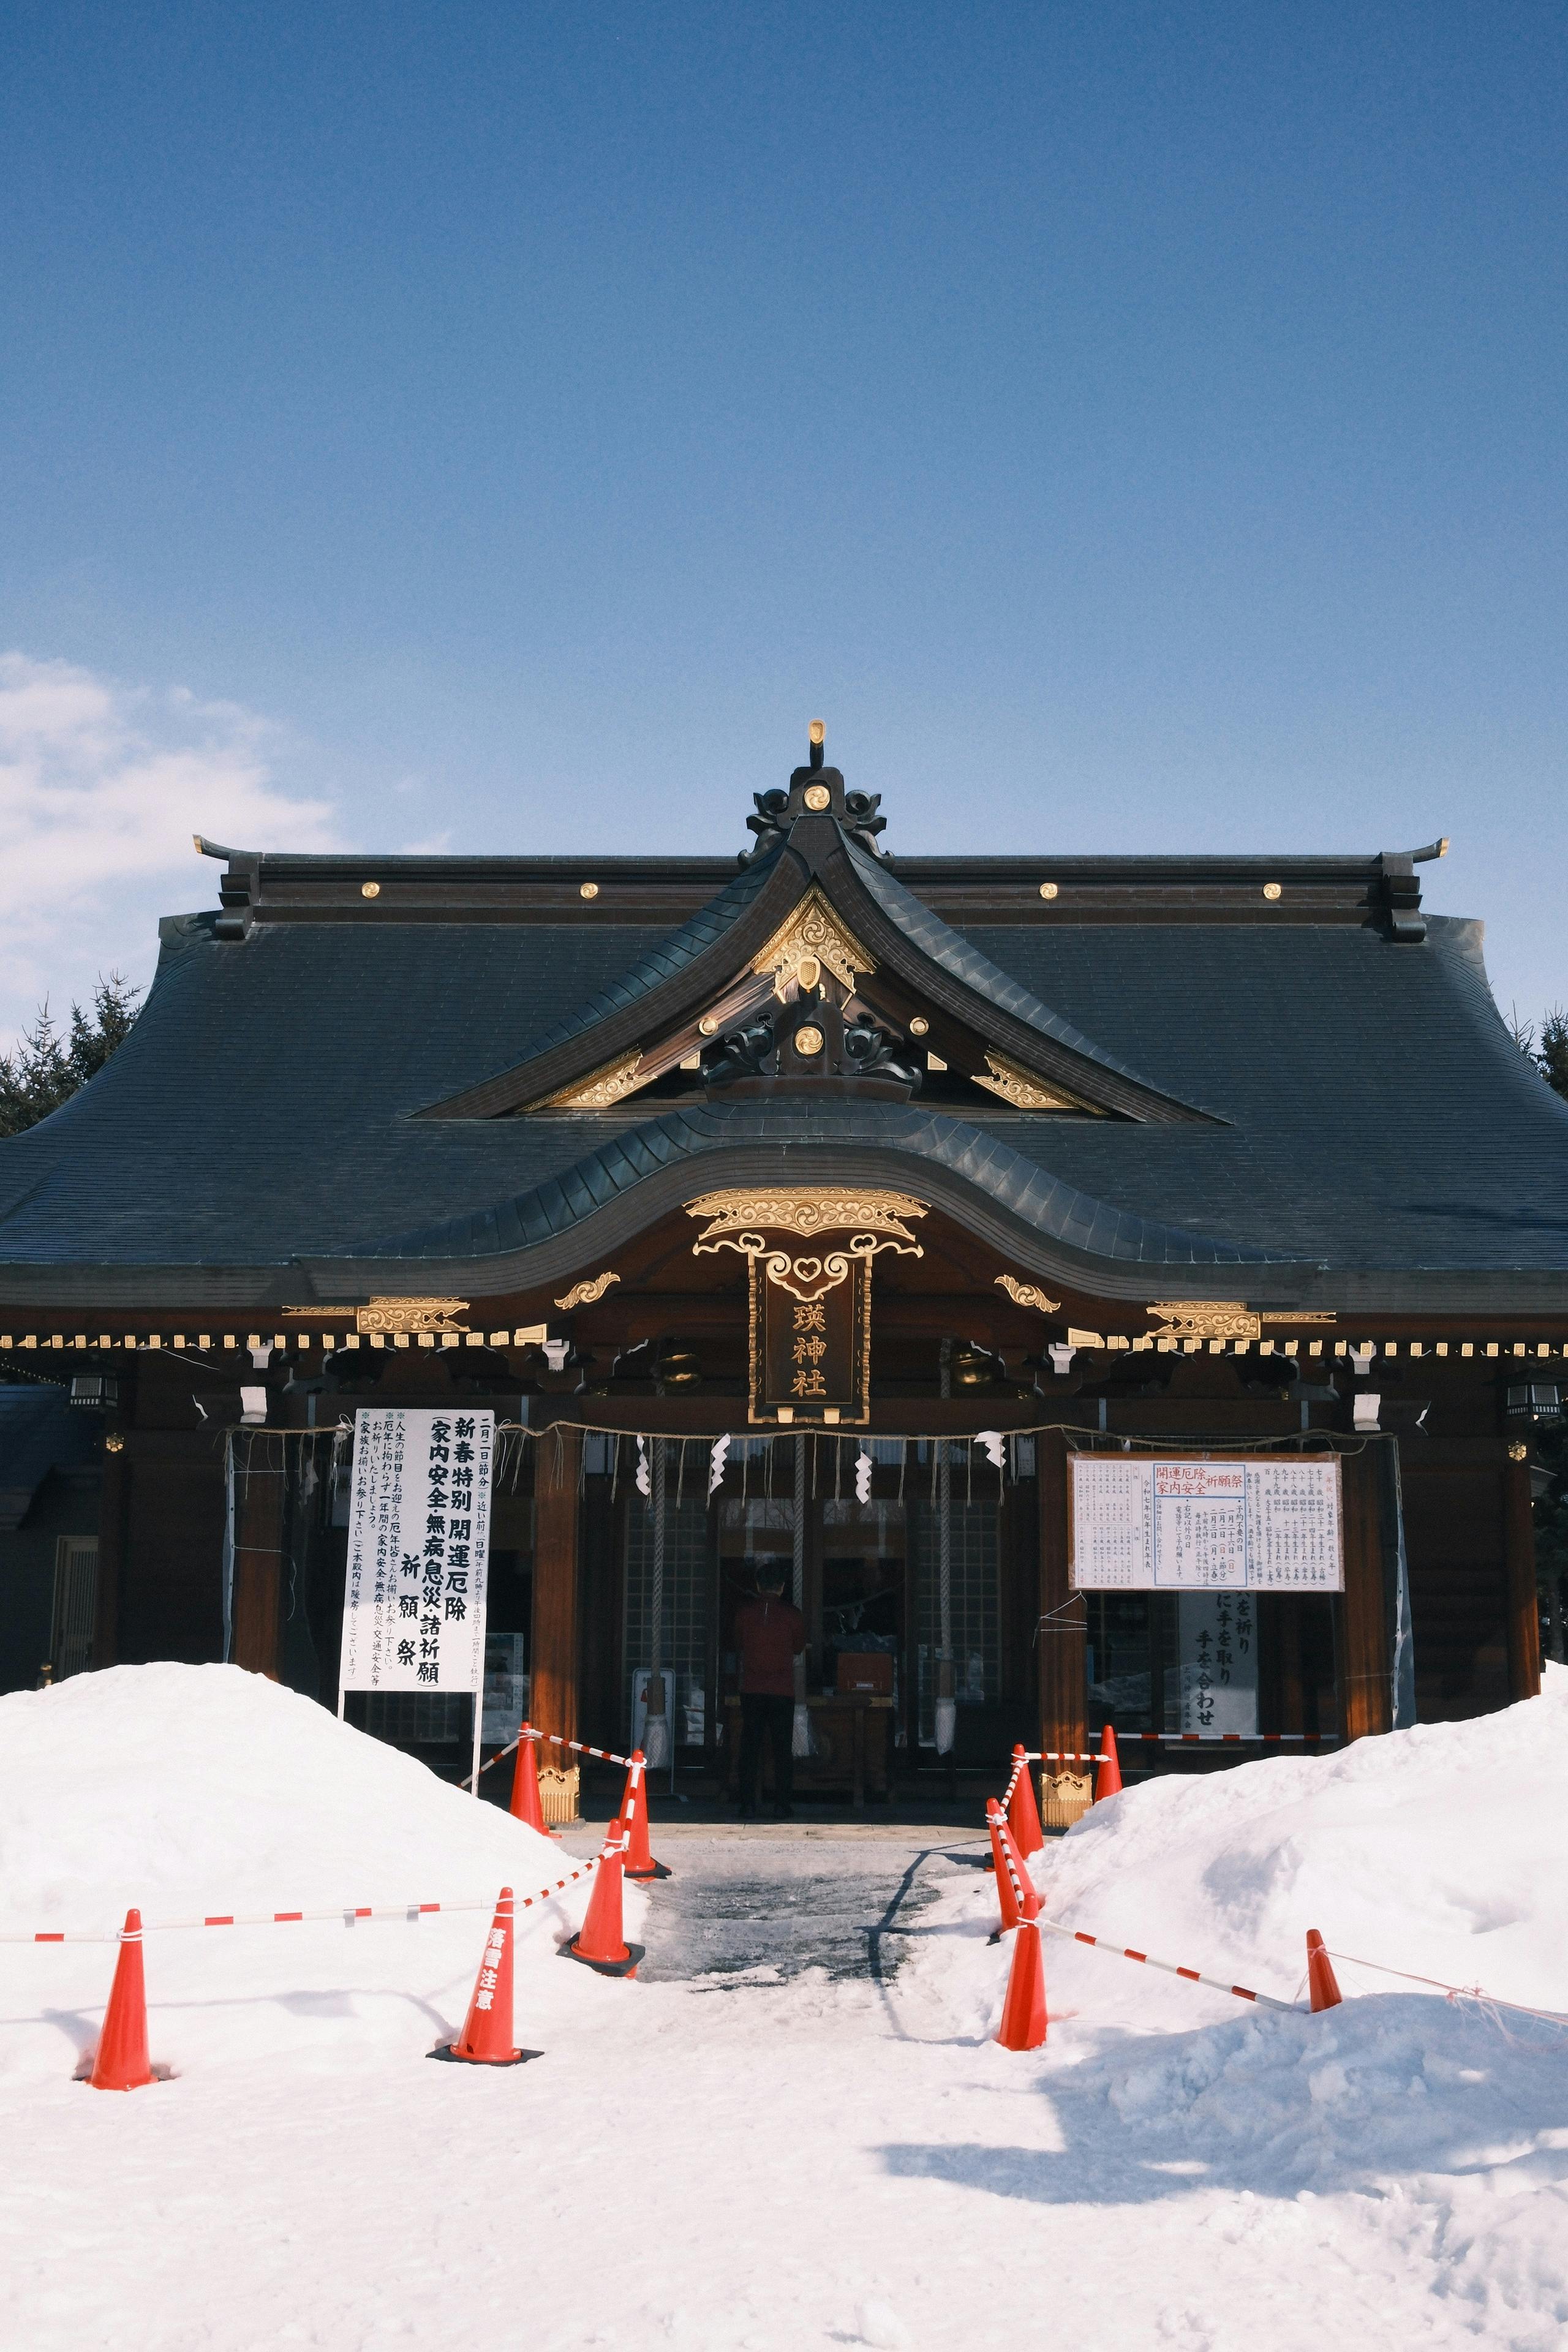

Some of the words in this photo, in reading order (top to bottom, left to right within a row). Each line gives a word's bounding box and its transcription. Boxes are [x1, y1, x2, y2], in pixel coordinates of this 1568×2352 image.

[790, 1292, 827, 1397] 瑛神社
[1156, 1466, 1206, 1480] 開運厄除
[1156, 1480, 1207, 1495] 家内安全
[1206, 1474, 1243, 1488] 祈願祭
[397, 1553, 421, 1666] 祈願祭
[1235, 1591, 1253, 1654] を祈り
[1196, 1629, 1215, 1726] 手を合わせ
[475, 1927, 507, 2010] 落雪注意
